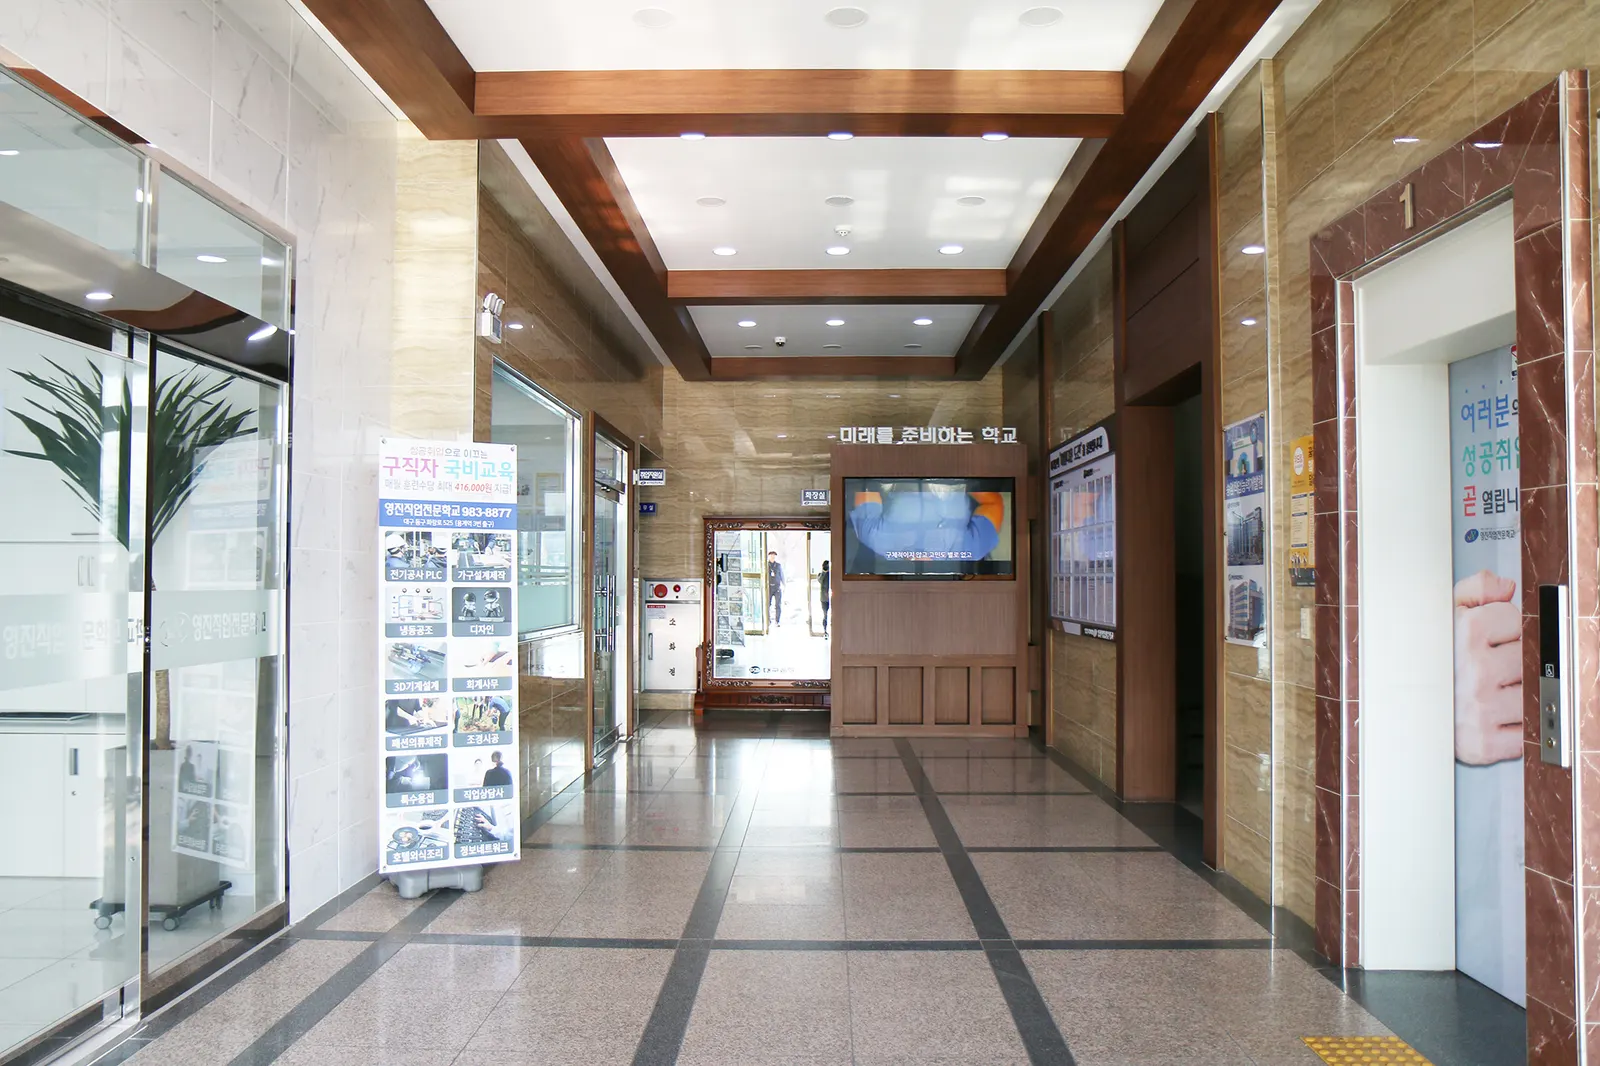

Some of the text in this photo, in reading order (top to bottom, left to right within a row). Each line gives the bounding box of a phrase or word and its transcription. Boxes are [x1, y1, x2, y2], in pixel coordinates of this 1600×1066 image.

[1399, 182, 1414, 229] 1
[839, 427, 1017, 444] 미래를 준비하는 학교
[410, 446, 488, 459] 성공취업으로 이끄는
[382, 456, 515, 482] 구직자 국비교육
[384, 479, 512, 495] 매월 훈련수당 최대 416,000원 지급!
[805, 491, 826, 500] 화장실
[1463, 485, 1477, 517] 곧
[384, 502, 512, 518] 영진직업전문학교 983-8877
[403, 518, 414, 526] 대구
[415, 518, 426, 526] 동구
[472, 520, 482, 528] 3번
[1480, 528, 1516, 542] 영진직업전문학교
[885, 551, 972, 559] 구체적이지 않고 고민도 별로 없고
[390, 570, 442, 580] 전기공사 PLC
[457, 570, 506, 580] 가구설계제작
[400, 625, 433, 636] 냉동공조
[470, 625, 494, 635] 디자인
[393, 680, 440, 692] 3D기계설계
[466, 679, 499, 690] 회계사무
[391, 736, 443, 749] 패션의류제작
[467, 734, 500, 744] 조경시공
[400, 792, 435, 805] 특수용접
[463, 788, 505, 800] 직업상담사
[392, 848, 443, 862] 호텔외식조리
[460, 842, 509, 856] 정보네트워크
